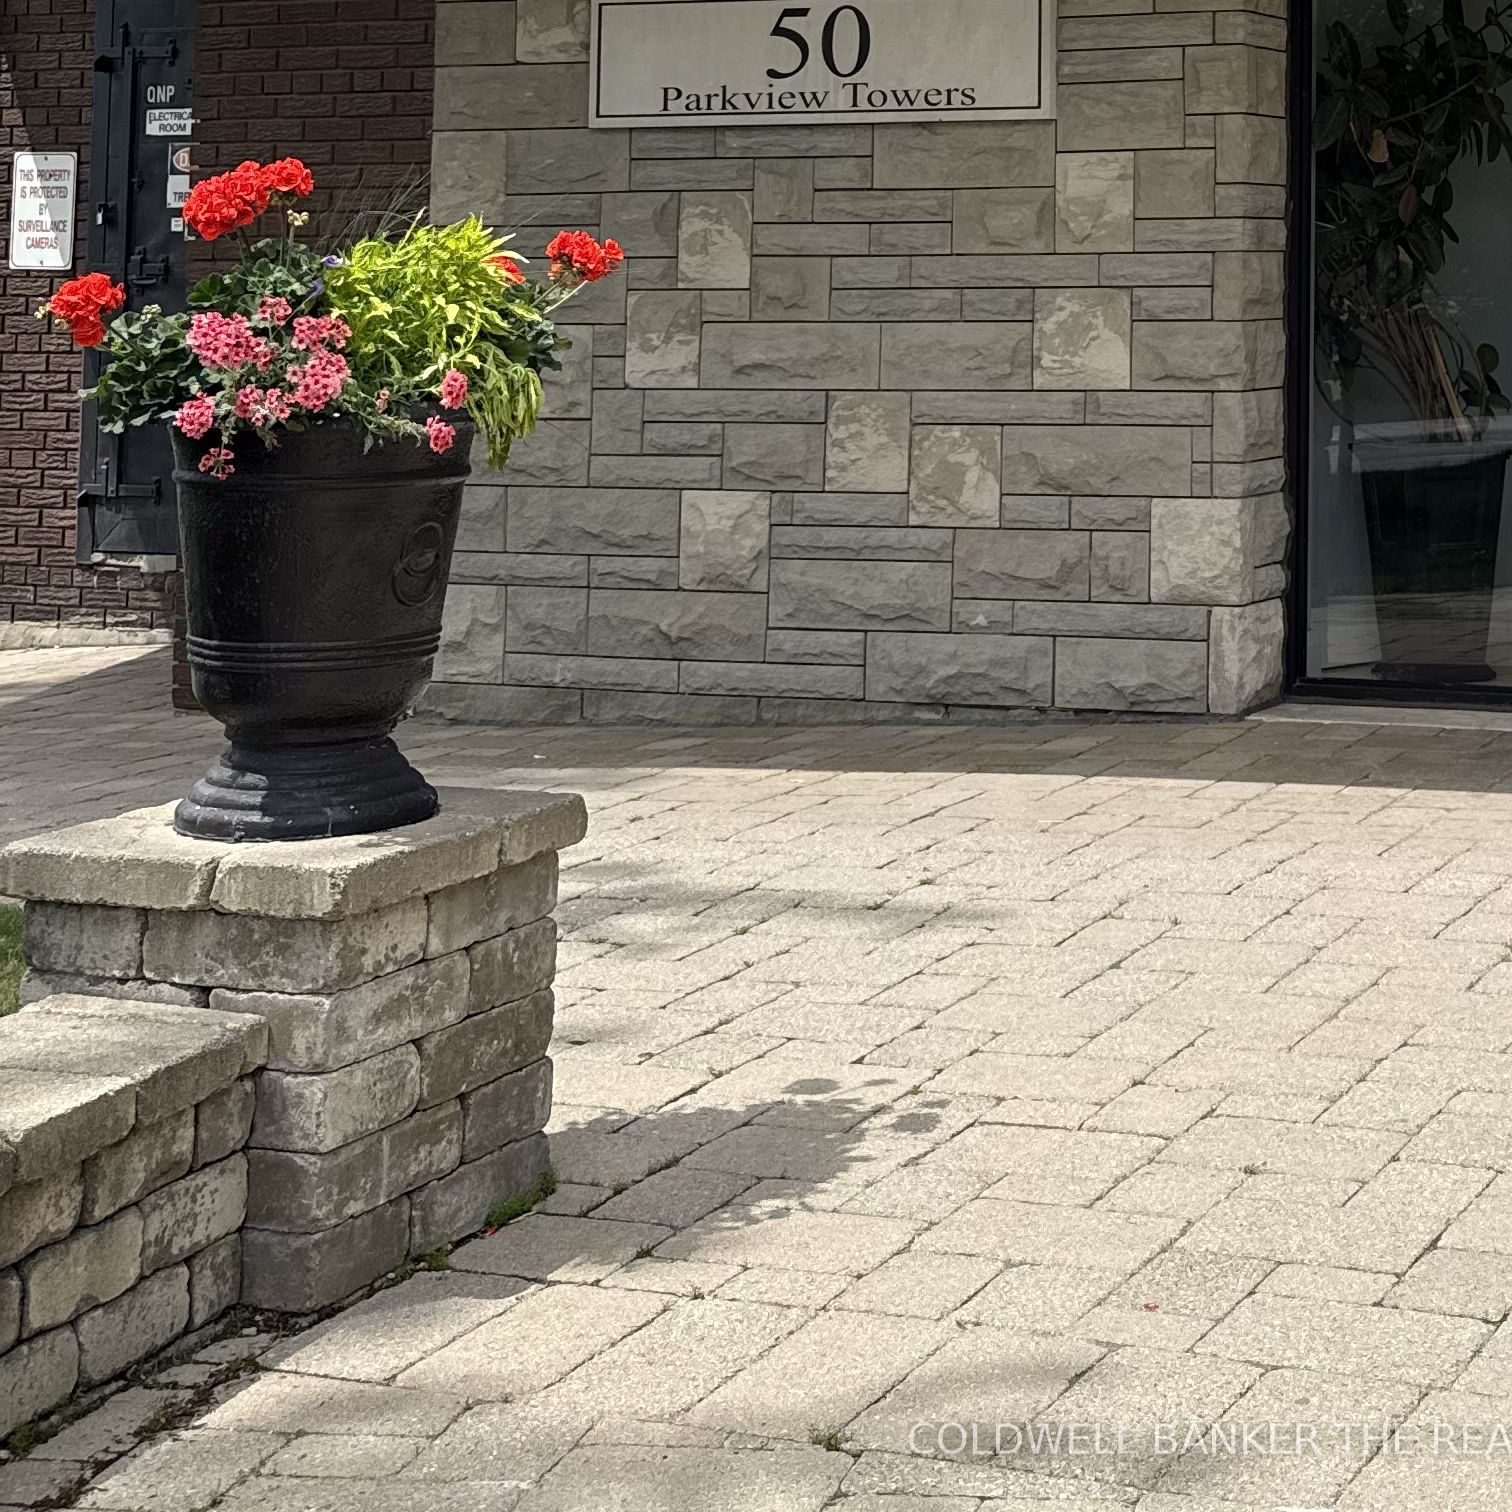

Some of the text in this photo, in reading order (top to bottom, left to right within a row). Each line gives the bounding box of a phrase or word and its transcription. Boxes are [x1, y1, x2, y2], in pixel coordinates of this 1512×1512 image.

[766, 5, 871, 80] 50
[146, 85, 175, 104] QNP
[660, 82, 977, 113] Parkview Towers
[149, 111, 192, 122] ELECTRICA
[159, 123, 187, 133] ROOM
[19, 169, 71, 181] THIS PROPERTY
[20, 186, 69, 199] IS PROTECTED
[38, 203, 49, 215] BY
[18, 219, 68, 232] SURVEILLANCE
[25, 236, 59, 249] CAMERAS
